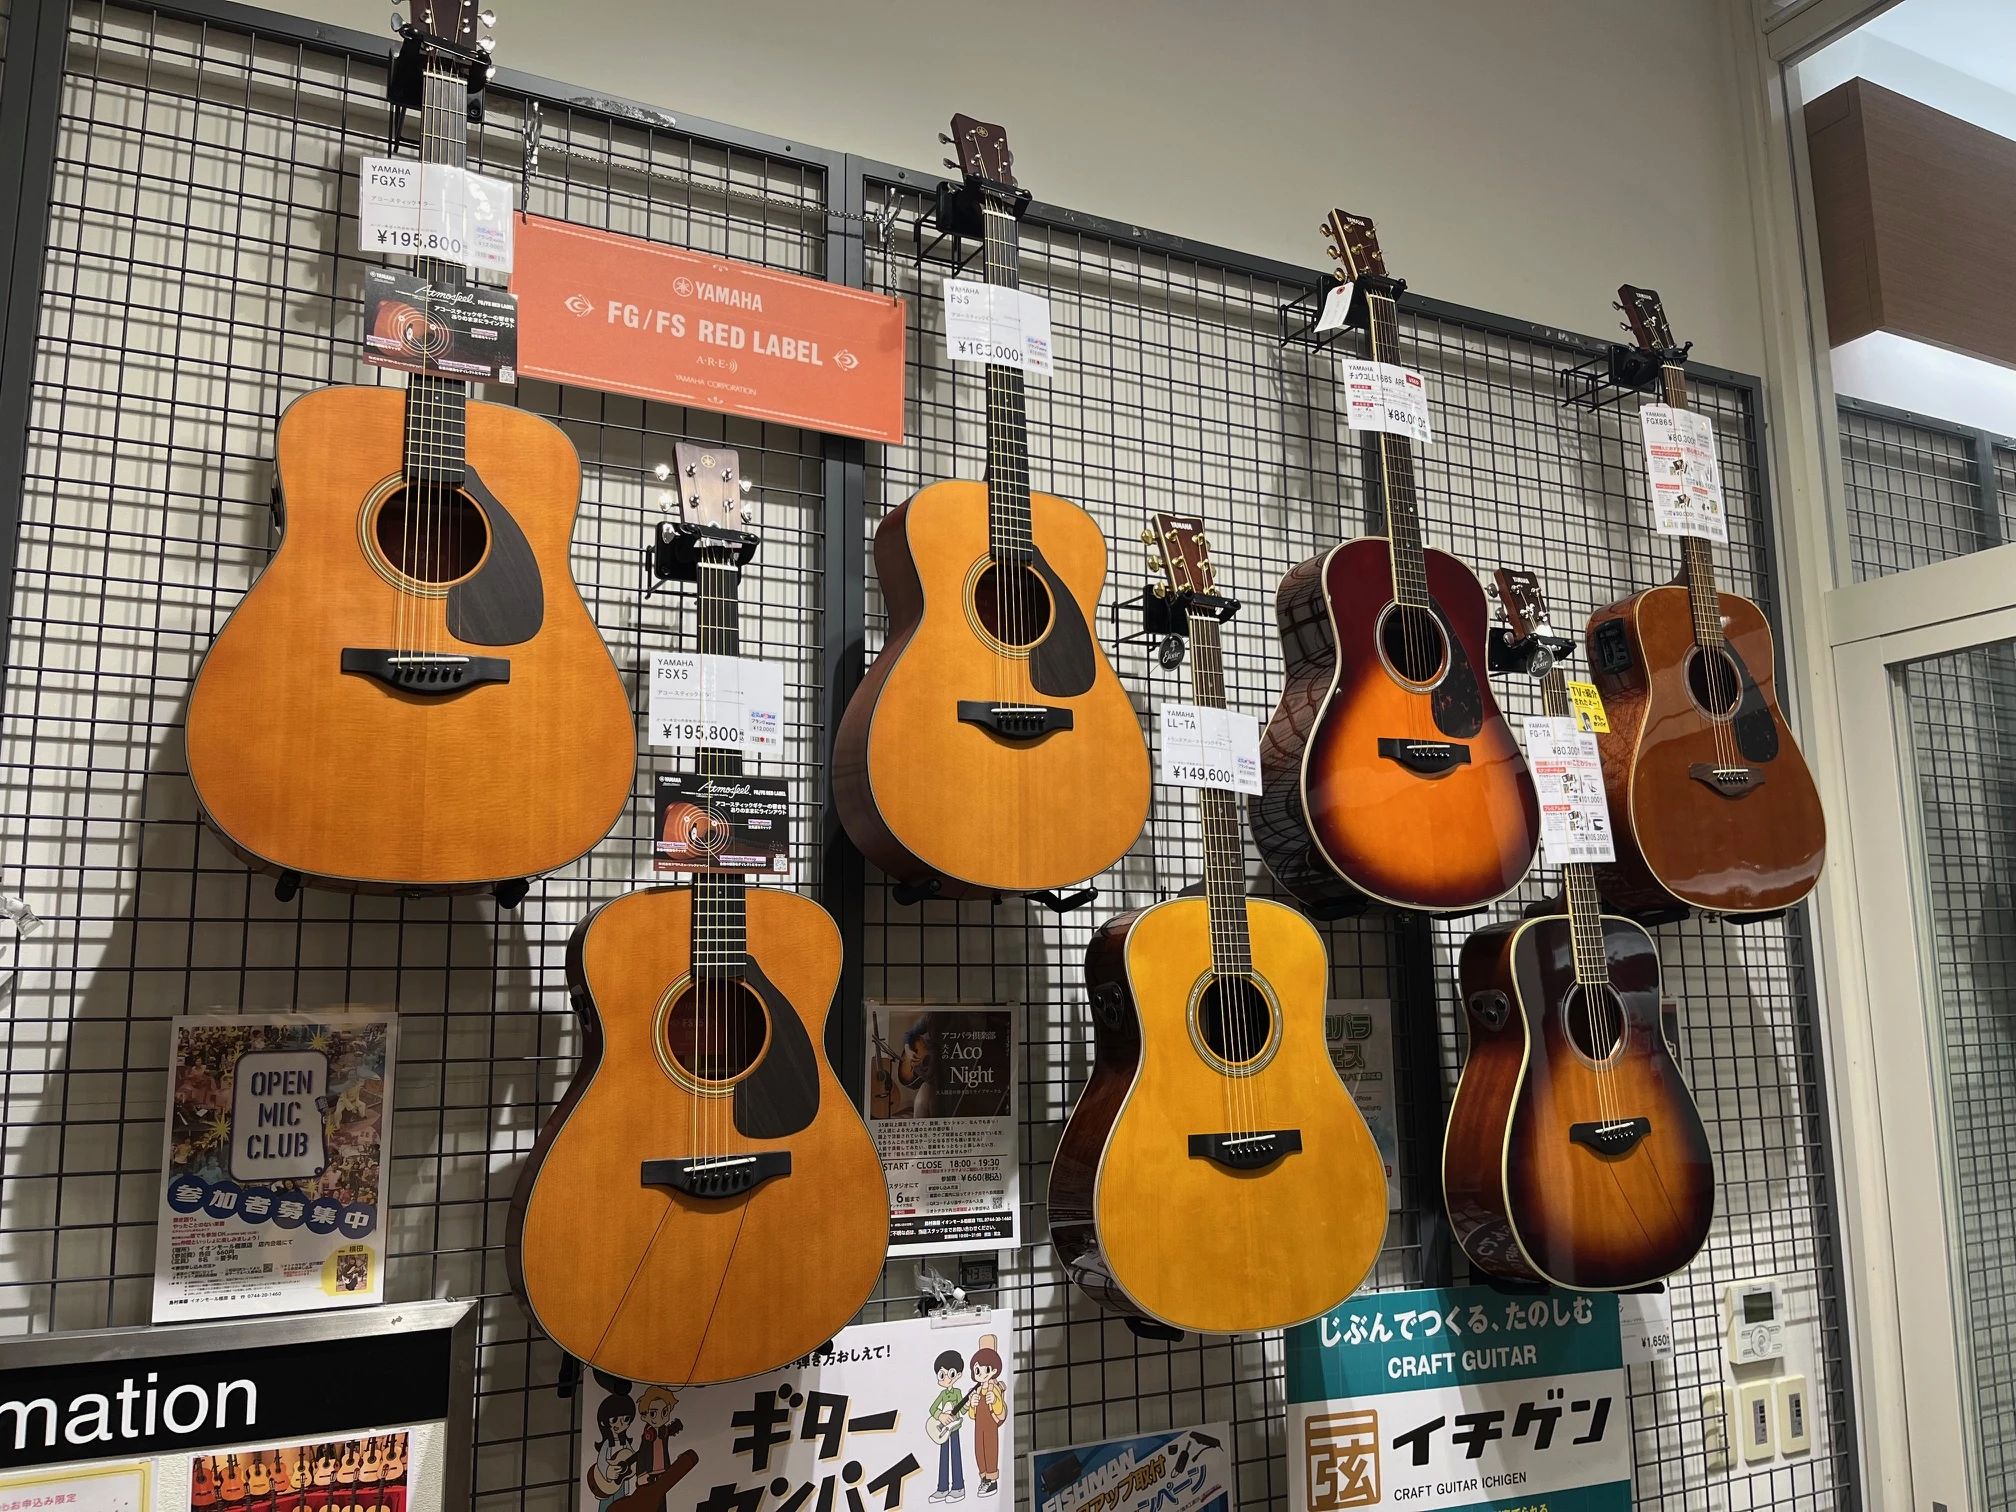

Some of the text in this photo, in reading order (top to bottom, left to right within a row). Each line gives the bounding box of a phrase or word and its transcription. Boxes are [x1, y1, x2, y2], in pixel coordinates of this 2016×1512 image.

[372, 165, 411, 176] YAMAHA
[371, 176, 406, 188] FGX5
[1346, 216, 1365, 227] YAMAHA
[377, 229, 461, 255] ¥195,800
[376, 272, 396, 282] YAMAHA
[695, 280, 763, 313] YAMAHA
[950, 286, 980, 296] YAMAHA
[698, 319, 746, 350] RED
[753, 330, 823, 367] LABEL
[1348, 365, 1374, 373] YAMAHA
[675, 374, 757, 397] YAMAHA CORPORATION
[1169, 520, 1193, 532] YAMAHA
[1511, 576, 1531, 586] YAMAHA
[657, 657, 694, 668] YAMAHA
[1162, 650, 1181, 664] Elixir
[1531, 659, 1549, 672] Elixir
[657, 668, 689, 680] FSX5
[1166, 710, 1195, 719] YAMAHA
[1167, 719, 1196, 730] LL-TA
[662, 723, 739, 743] ¥195,800
[1529, 730, 1551, 738] FG-TA
[1173, 765, 1231, 784] ¥149,600
[950, 1042, 983, 1060] Aco
[250, 1070, 313, 1097] OPEN
[949, 1066, 994, 1088] Night
[257, 1100, 302, 1127] MIC
[246, 1132, 309, 1160] CLUB
[883, 1158, 1000, 1171] START CLOSE 18:00 19:30
[175, 1184, 370, 1230] 参加者募集中
[1641, 1334, 1667, 1349] ¥1,650
[1387, 1344, 1537, 1380] CRAFT GUITAR
[730, 1382, 900, 1473] ギター
[1392, 1387, 1613, 1467] イチゲン
[1393, 1471, 1527, 1502] CRAFT GUITAR ICHIGEN
